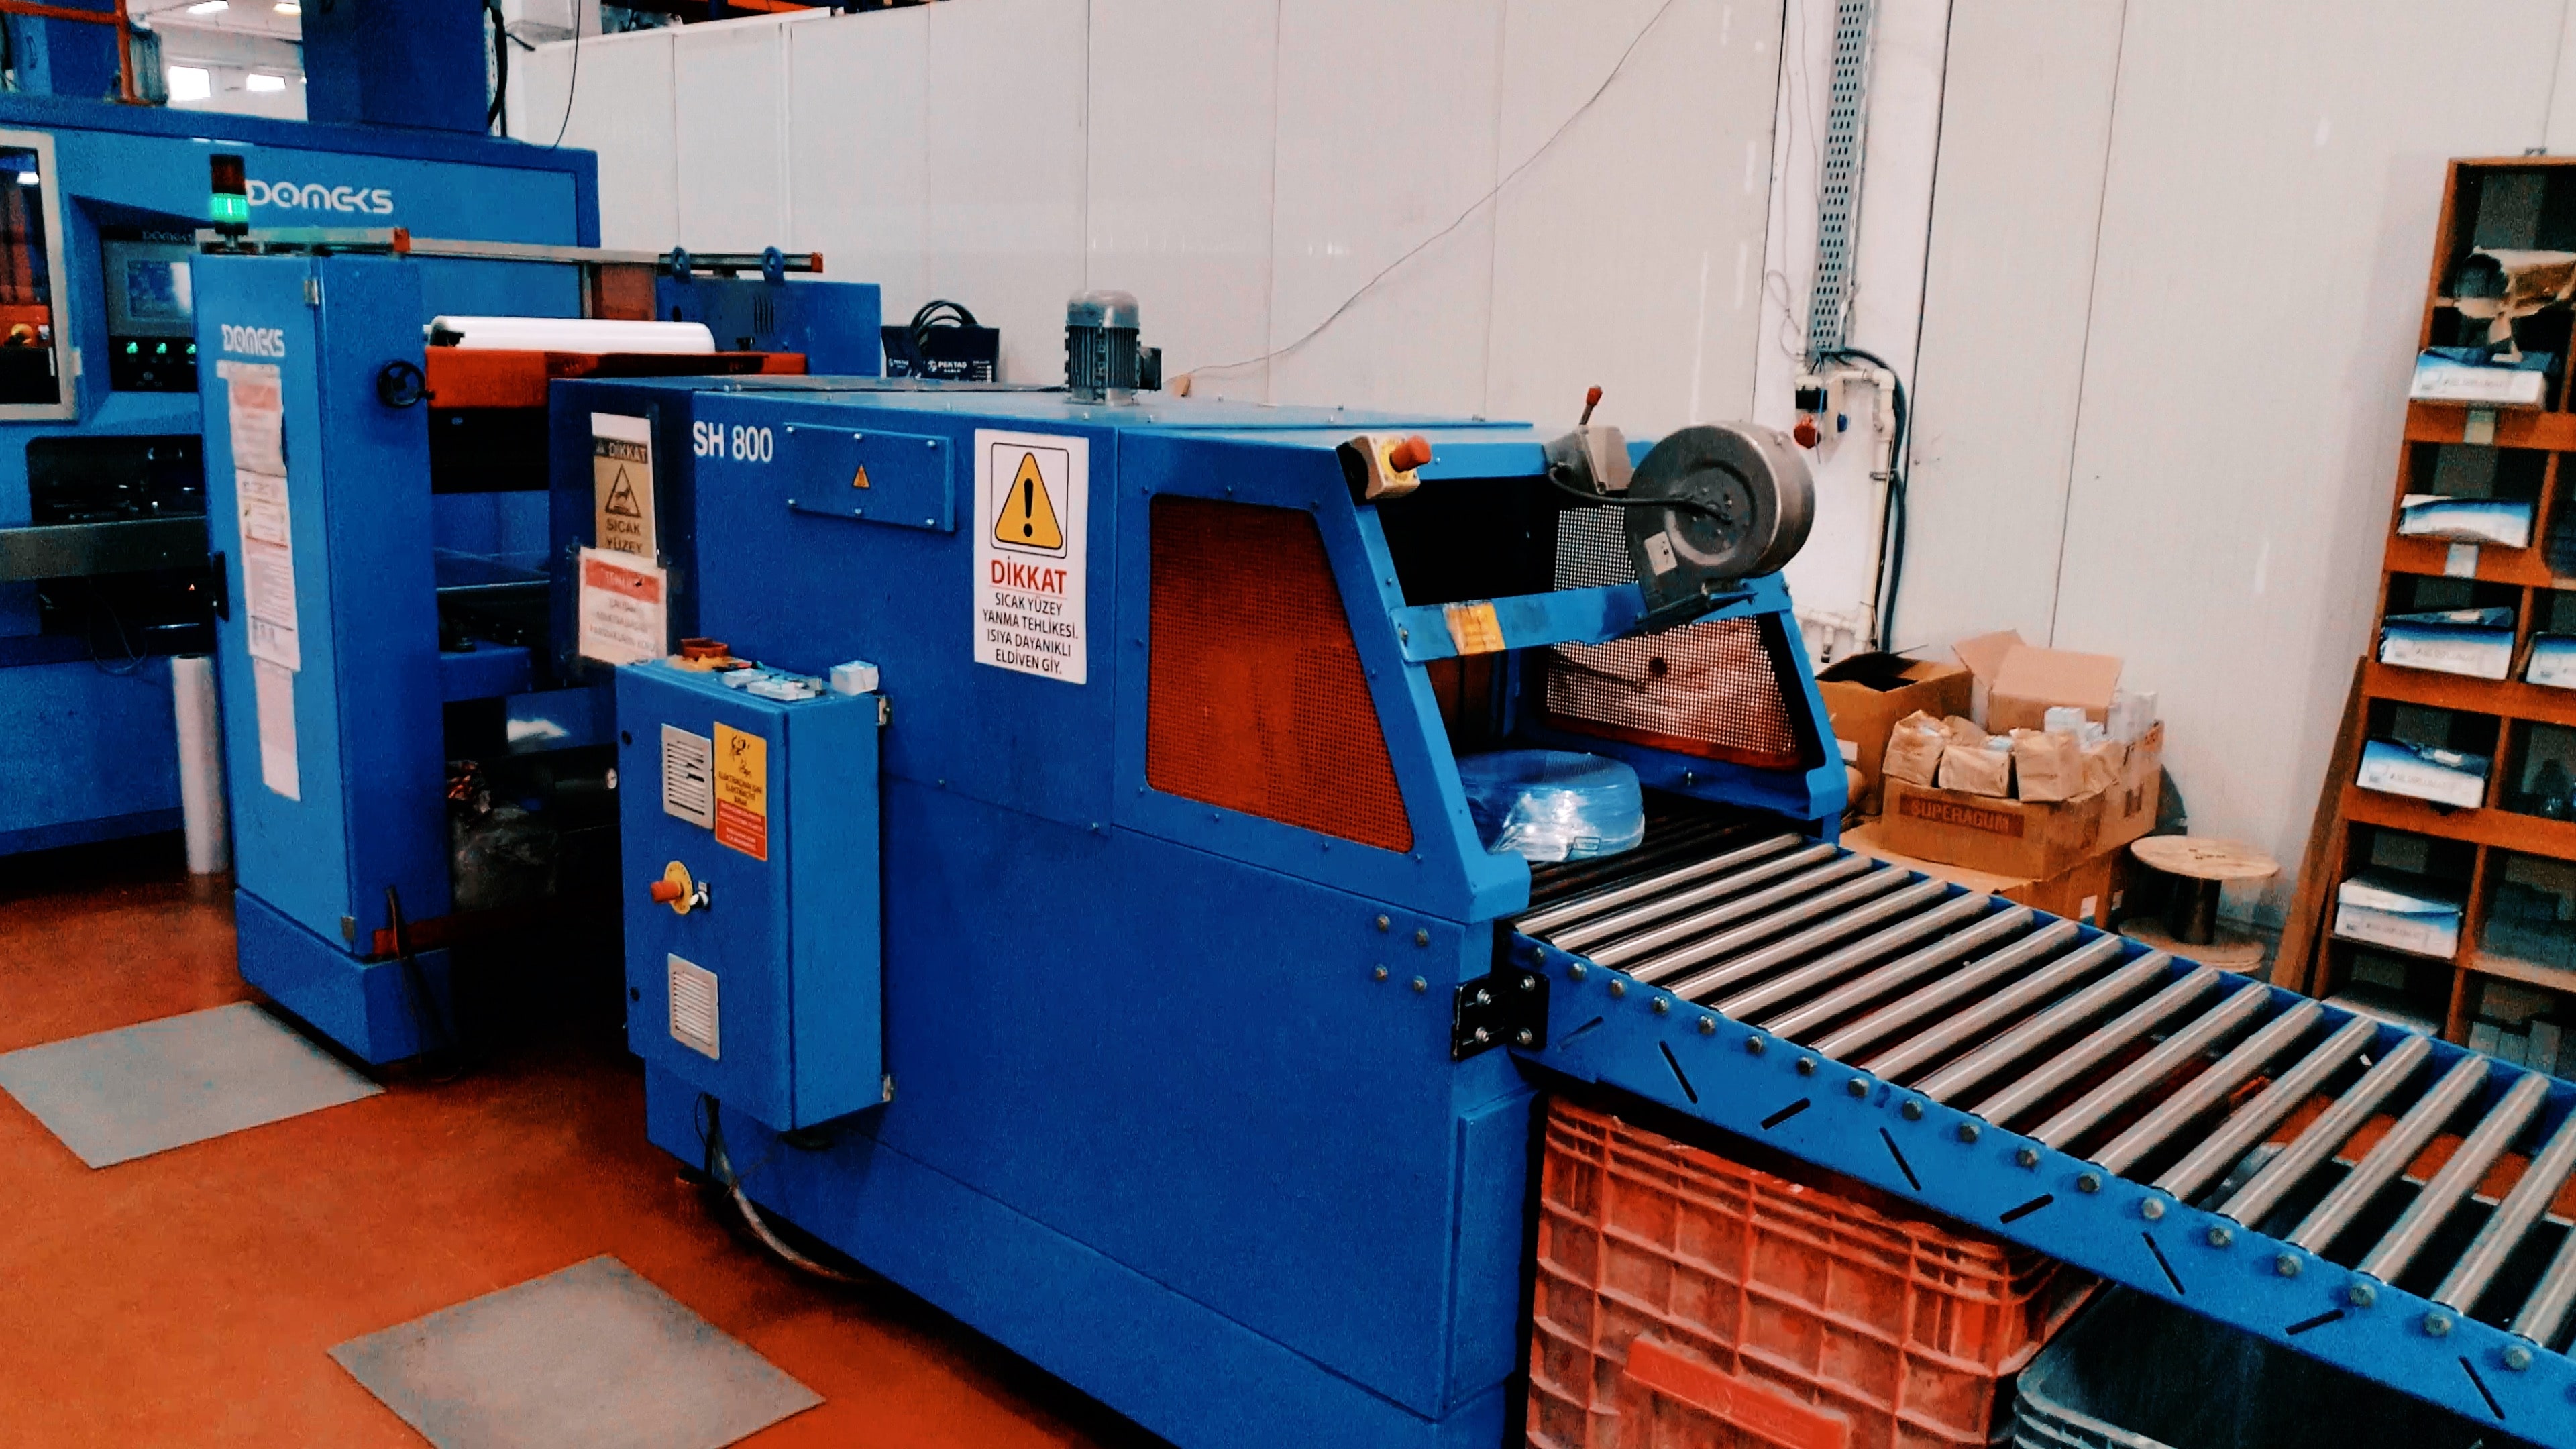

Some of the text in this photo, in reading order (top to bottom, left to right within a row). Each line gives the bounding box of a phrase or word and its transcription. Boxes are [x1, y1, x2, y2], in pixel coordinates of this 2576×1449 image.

[692, 420, 773, 462] SH 800
[606, 517, 641, 535] SICAK
[991, 555, 1067, 594] DİKKAT
[995, 592, 1063, 616] SICAK YÜZEY
[982, 608, 1079, 640] YANMA TEHLİKESİ.
[987, 628, 1071, 657] ISIYA DAYANIKLI
[996, 648, 1063, 675] ELDİVEN GİY.
[1912, 799, 2009, 833] SUPERAGUM
